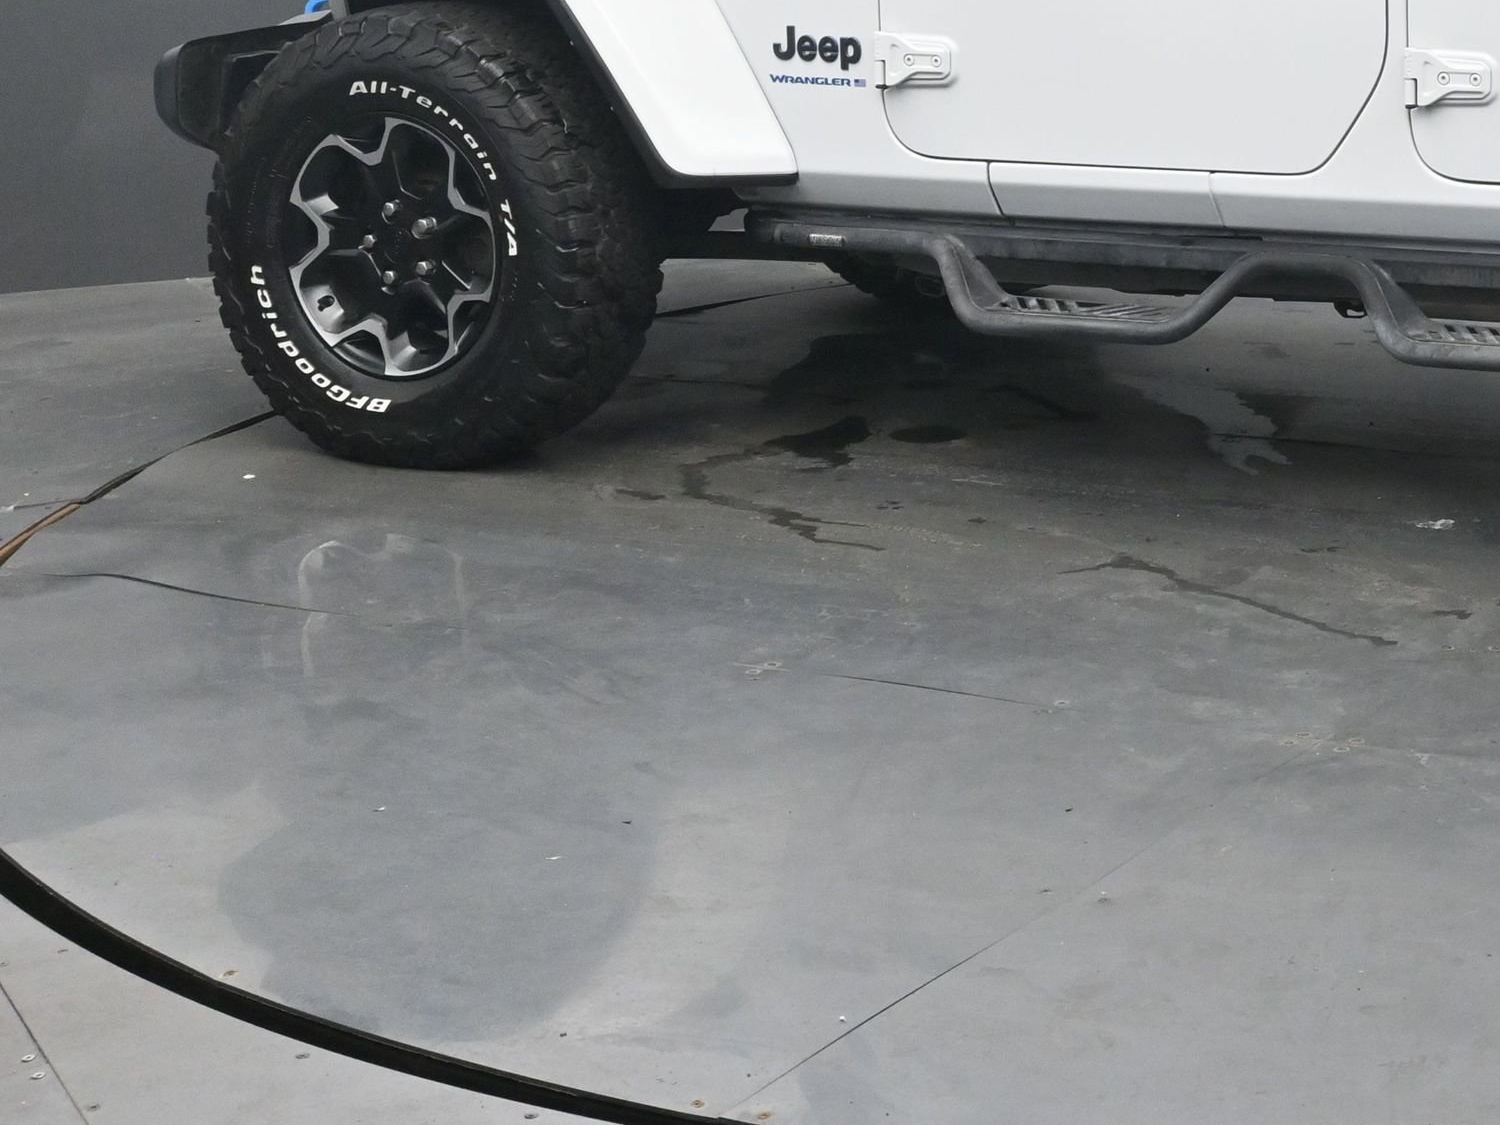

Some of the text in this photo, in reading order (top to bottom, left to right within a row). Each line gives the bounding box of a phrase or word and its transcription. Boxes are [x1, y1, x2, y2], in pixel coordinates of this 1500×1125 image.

[769, 74, 851, 87] WRANGLER
[773, 25, 862, 71] Jeep
[349, 80, 518, 257] All-Terrain T/A
[249, 265, 392, 413] BFGoodrich
